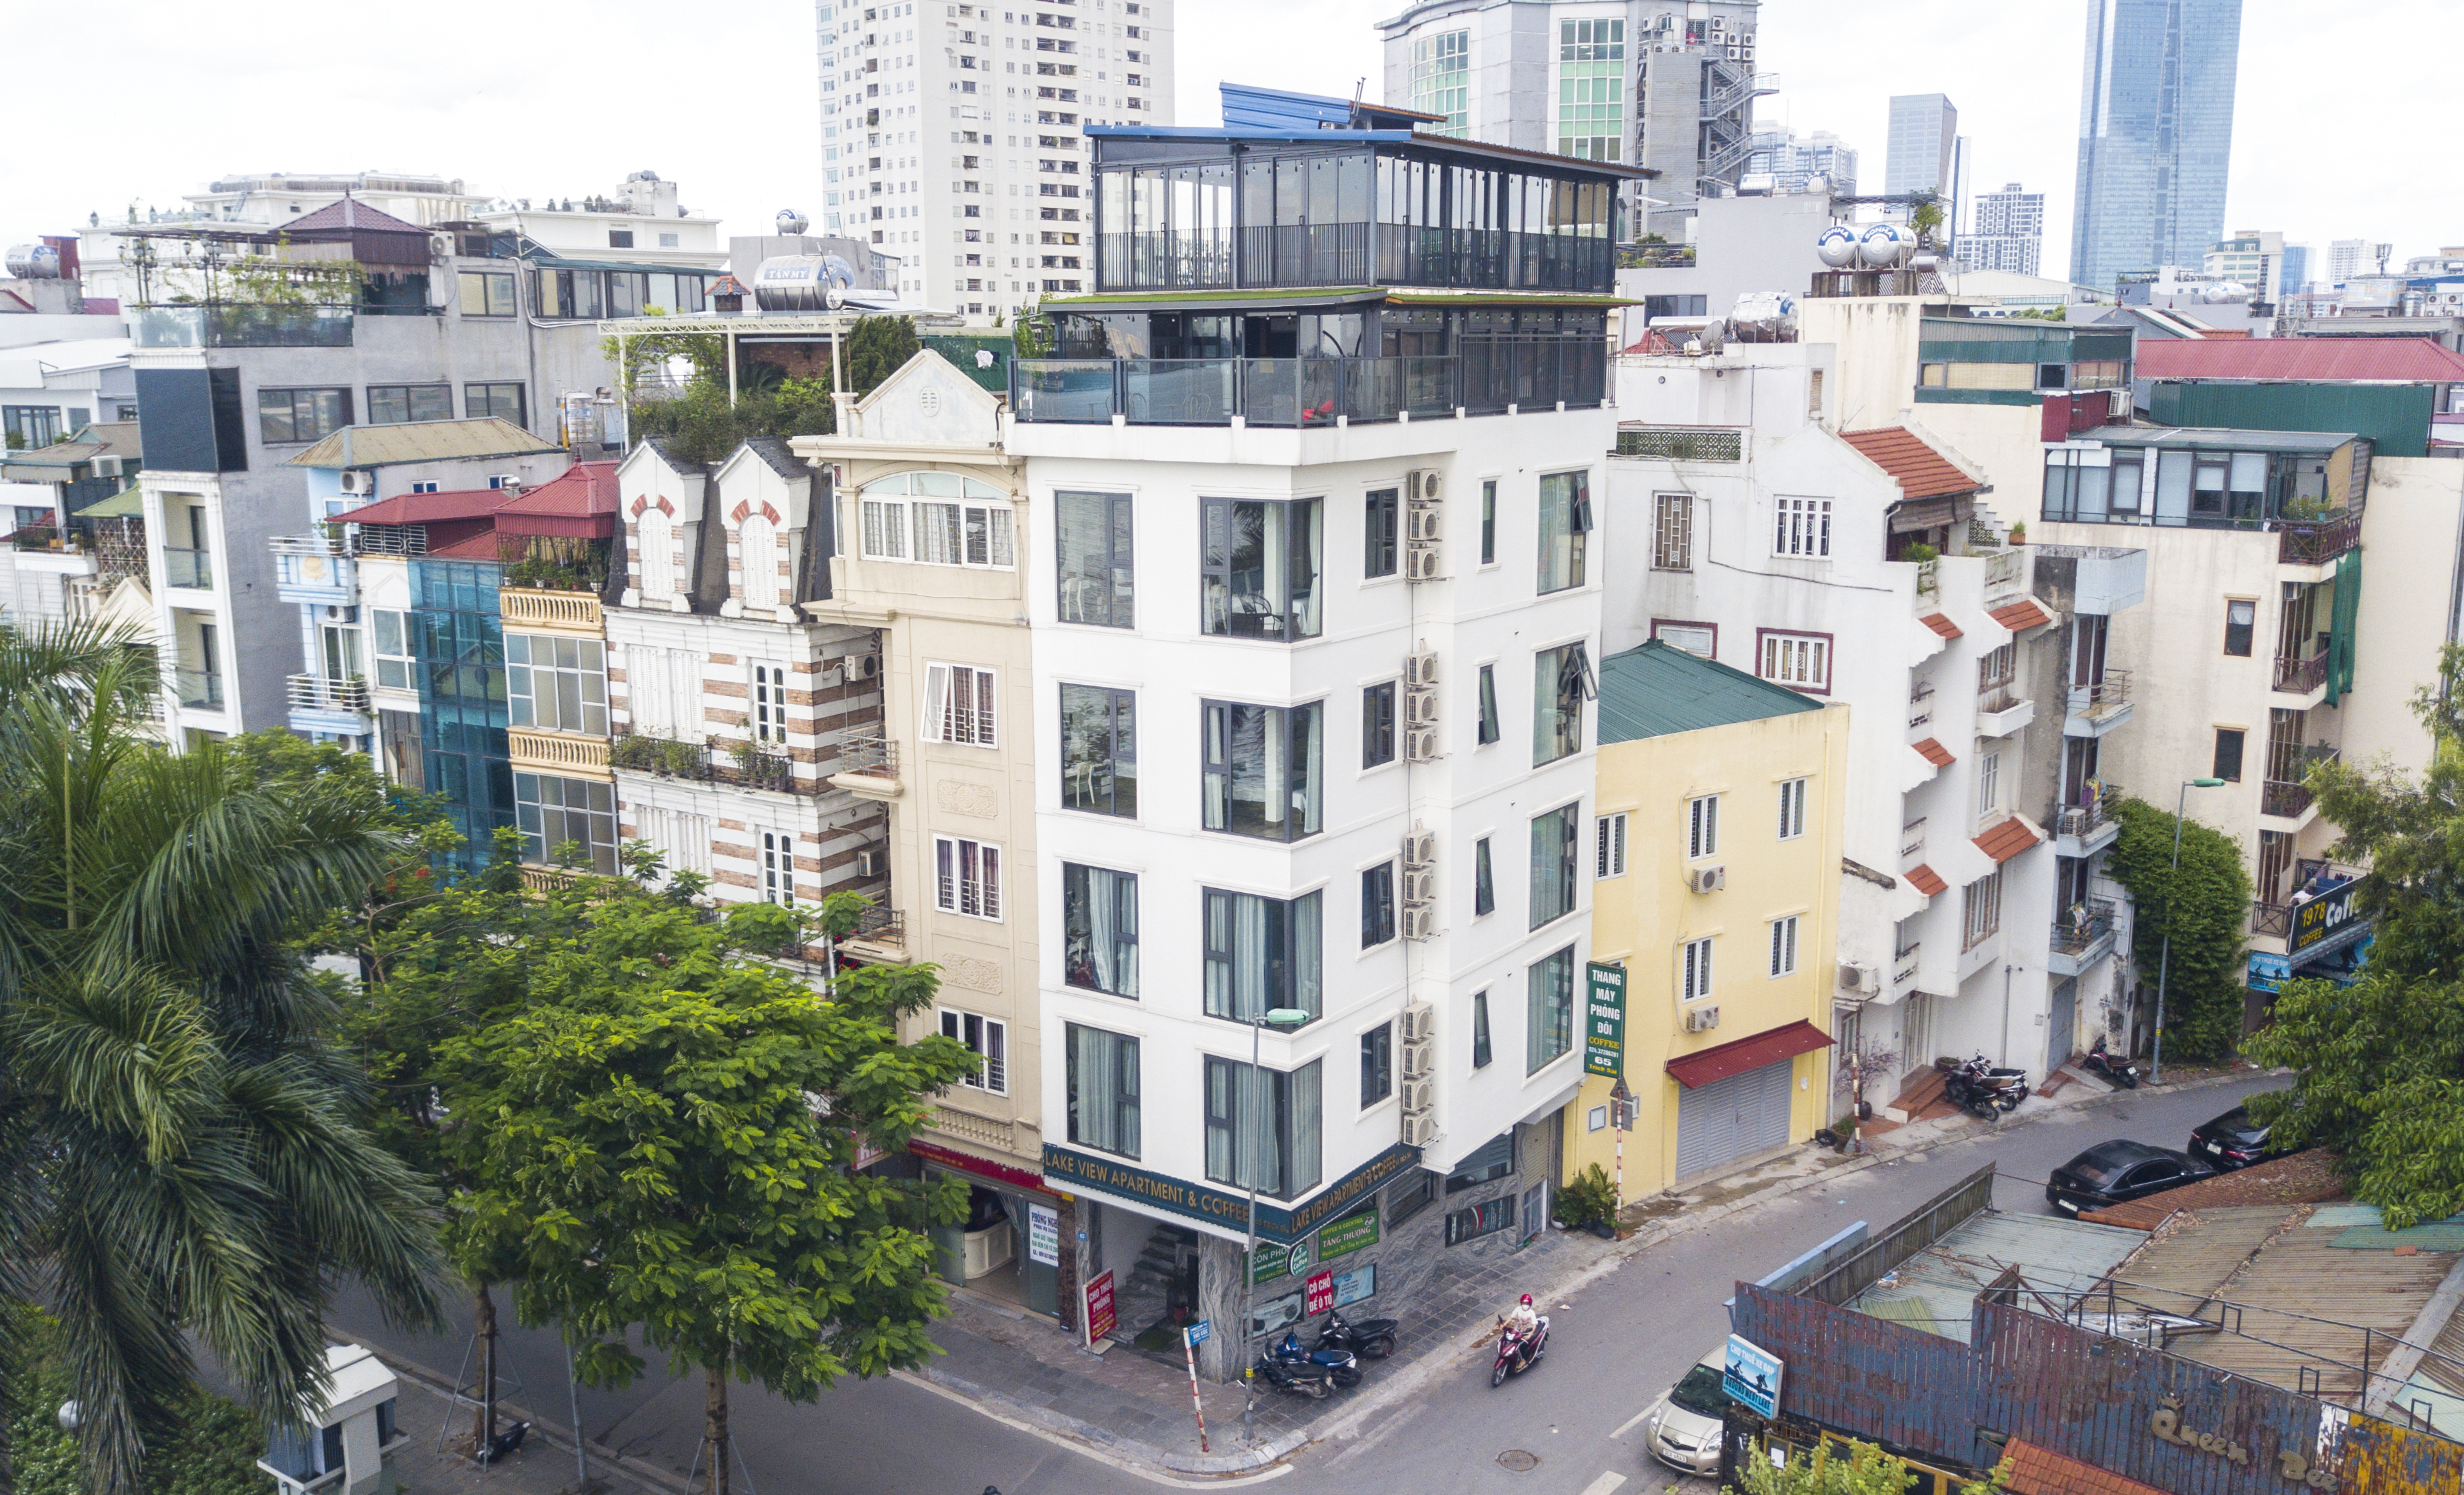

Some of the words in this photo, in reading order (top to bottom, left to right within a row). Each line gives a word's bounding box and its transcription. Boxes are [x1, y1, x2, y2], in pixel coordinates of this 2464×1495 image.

[1821, 228, 1849, 241] SONHA
[1865, 226, 1893, 239] SONHA
[769, 268, 790, 279] TÂN
[789, 267, 808, 279] MỸ
[2303, 902, 2326, 928] 1978
[2299, 926, 2323, 948] COFFEE
[1592, 969, 1621, 986] THANG
[1596, 987, 1615, 1002] MÁY
[1590, 1004, 1620, 1020] PHÒNG
[1597, 1021, 1612, 1036] ĐÔI
[1589, 1036, 1619, 1050] COFFEE
[1594, 1056, 1612, 1066] 65
[1045, 1150, 1074, 1173] LAKE
[1077, 1159, 1108, 1182] VIEW
[1111, 1170, 1183, 1204] APARTMENT
[1188, 1190, 1197, 1208] &
[1201, 1194, 1249, 1224] COFFEE
[1291, 1208, 1310, 1234] LAKE
[1311, 1195, 1328, 1221] VIEW
[1329, 1172, 1367, 1210] APARTMENT
[1367, 1169, 1373, 1186] &
[1371, 1154, 1396, 1181] COFFEE
[1321, 1226, 1337, 1236] COFFEE
[1343, 1218, 1363, 1229] COCKTAIL
[1089, 1288, 1100, 1303] CHO
[1100, 1277, 1113, 1295] THUÊ
[1319, 1295, 1323, 1308] Ô
[1324, 1292, 1332, 1306] TÔ
[1730, 1343, 1741, 1356] CHO
[1741, 1350, 1755, 1364] THUÊ
[1755, 1358, 1763, 1370] XE
[1725, 1377, 1745, 1395] AROUND
[1745, 1388, 1759, 1403] WEST
[1759, 1396, 1771, 1410] LAKE
[2278, 1450, 2337, 1492] Bee
